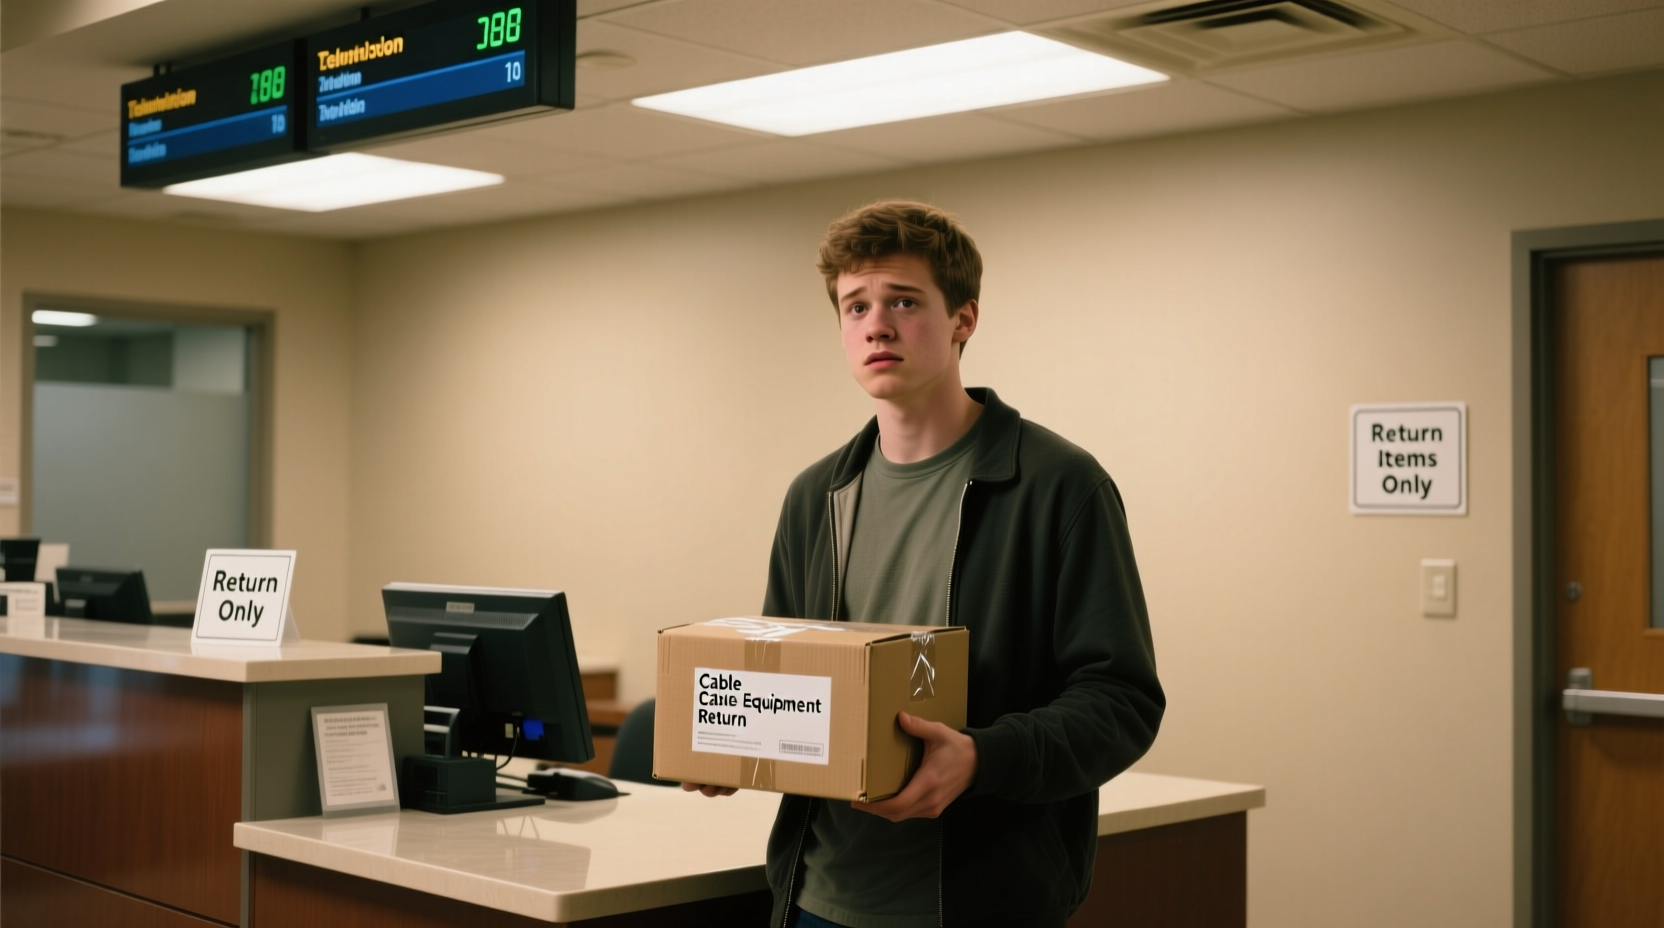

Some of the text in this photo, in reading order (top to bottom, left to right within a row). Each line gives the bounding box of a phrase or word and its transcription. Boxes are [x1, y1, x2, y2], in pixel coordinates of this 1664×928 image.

[505, 62, 521, 82] 10
[1372, 423, 1443, 442] Return
[1379, 450, 1437, 468] Items
[1382, 474, 1432, 500] Only
[212, 570, 278, 593] Return
[218, 599, 264, 628] Only
[699, 673, 742, 691] Cable
[743, 693, 822, 714] Equipment
[699, 709, 746, 727] Return
